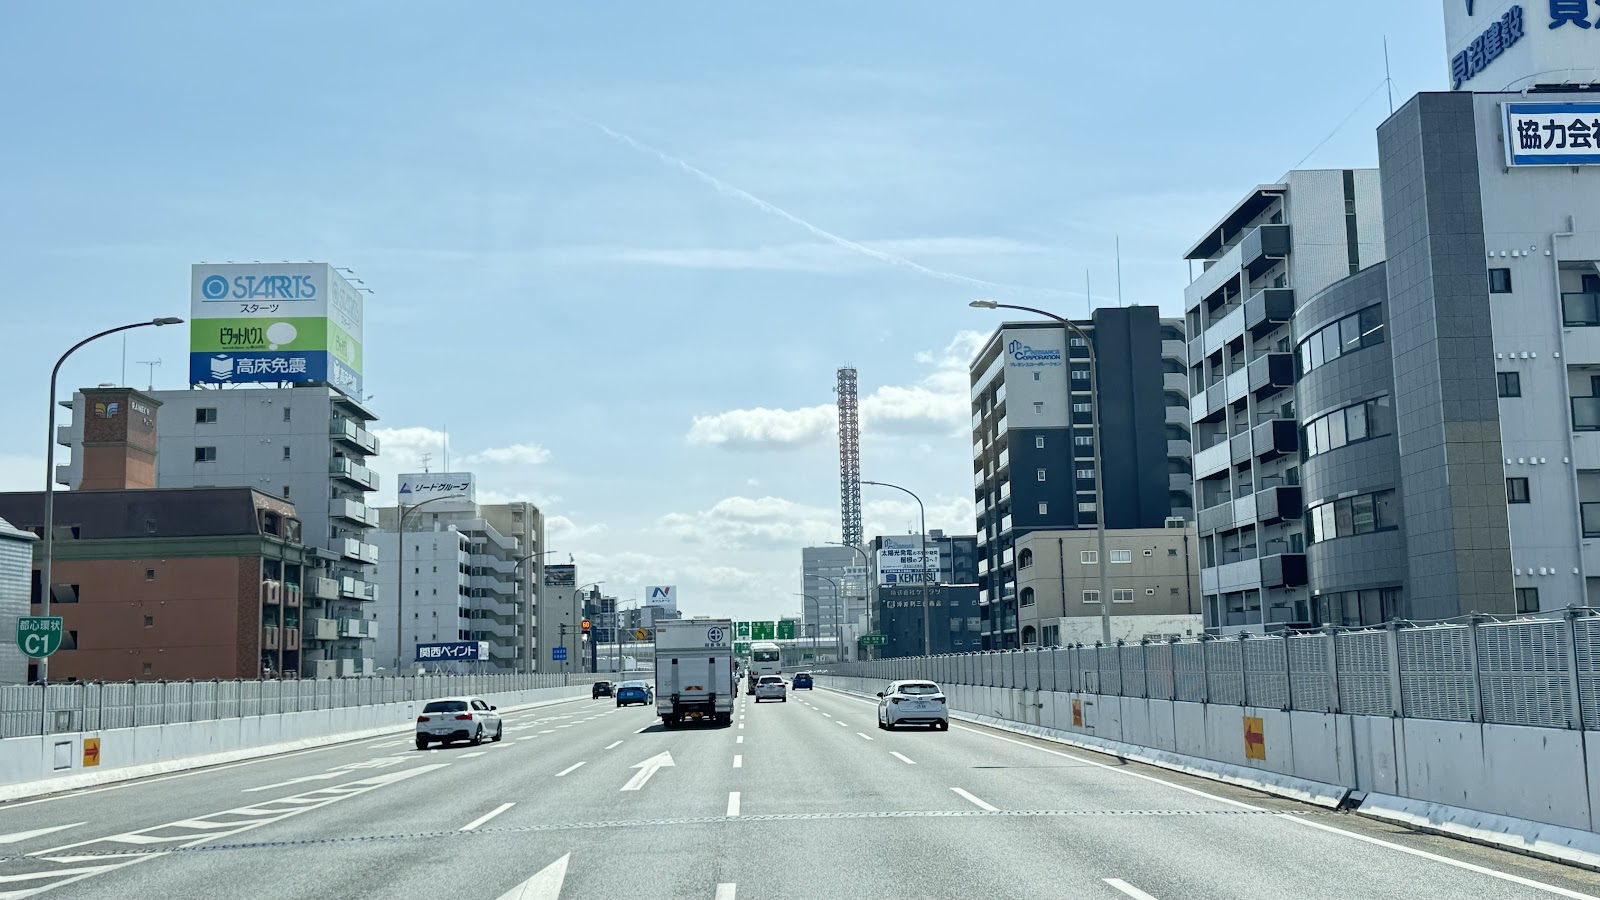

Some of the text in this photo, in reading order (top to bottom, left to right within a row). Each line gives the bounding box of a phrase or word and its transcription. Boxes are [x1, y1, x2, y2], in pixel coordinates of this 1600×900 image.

[1452, 5, 1524, 90] 貝沼建設
[240, 303, 279, 313] スターツ
[220, 327, 264, 345] ピタットハウス
[236, 357, 307, 375] 高床免震
[415, 482, 469, 491] リードグループ
[19, 620, 61, 631] 都心環状
[25, 633, 49, 654] C1
[419, 645, 477, 658] 関西ペイント
